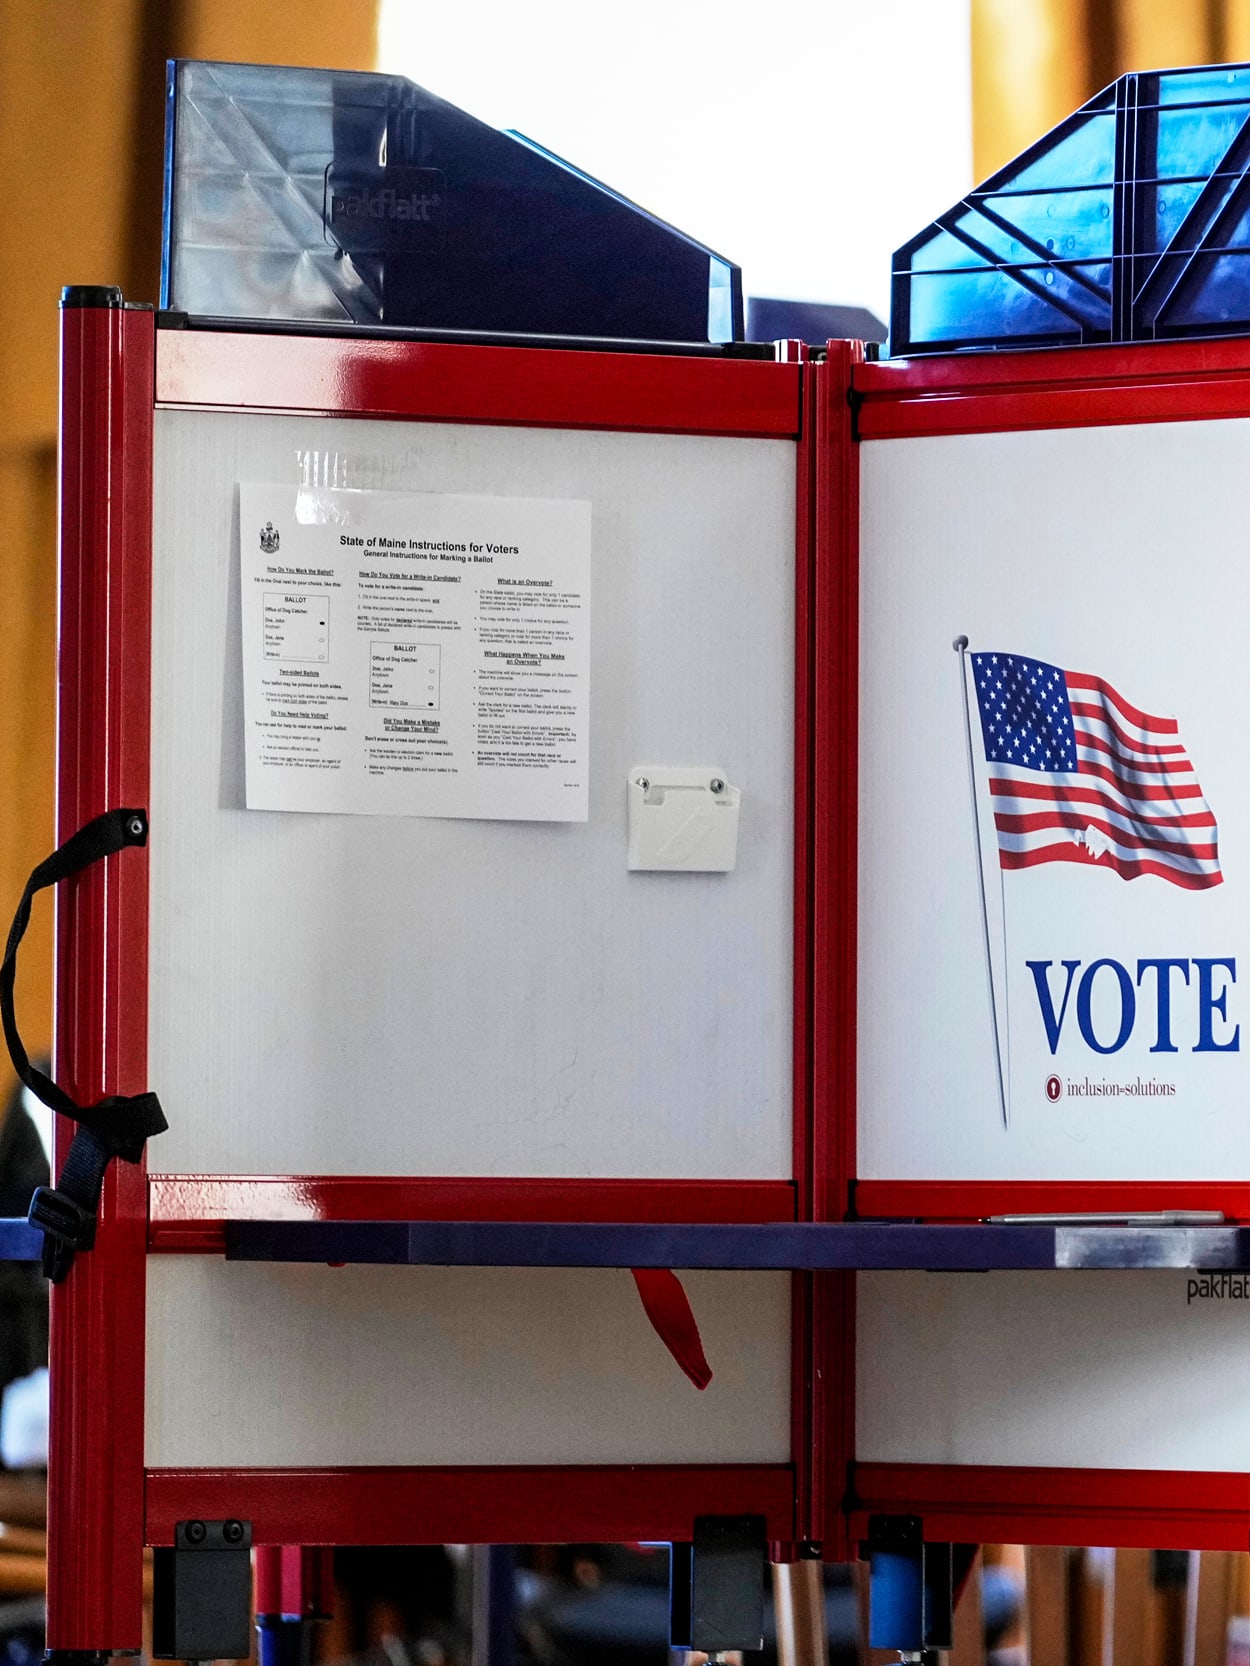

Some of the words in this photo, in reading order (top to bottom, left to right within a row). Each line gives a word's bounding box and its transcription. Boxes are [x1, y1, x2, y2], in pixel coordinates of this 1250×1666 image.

[340, 536, 364, 546] State
[366, 537, 376, 547] of
[379, 538, 406, 548] Maine
[410, 539, 466, 552] Instructions
[470, 542, 483, 552] for
[486, 544, 519, 554] Voters
[390, 551, 427, 560] Instructions
[440, 554, 466, 563] Marking
[1025, 957, 1240, 1055] VOTE
